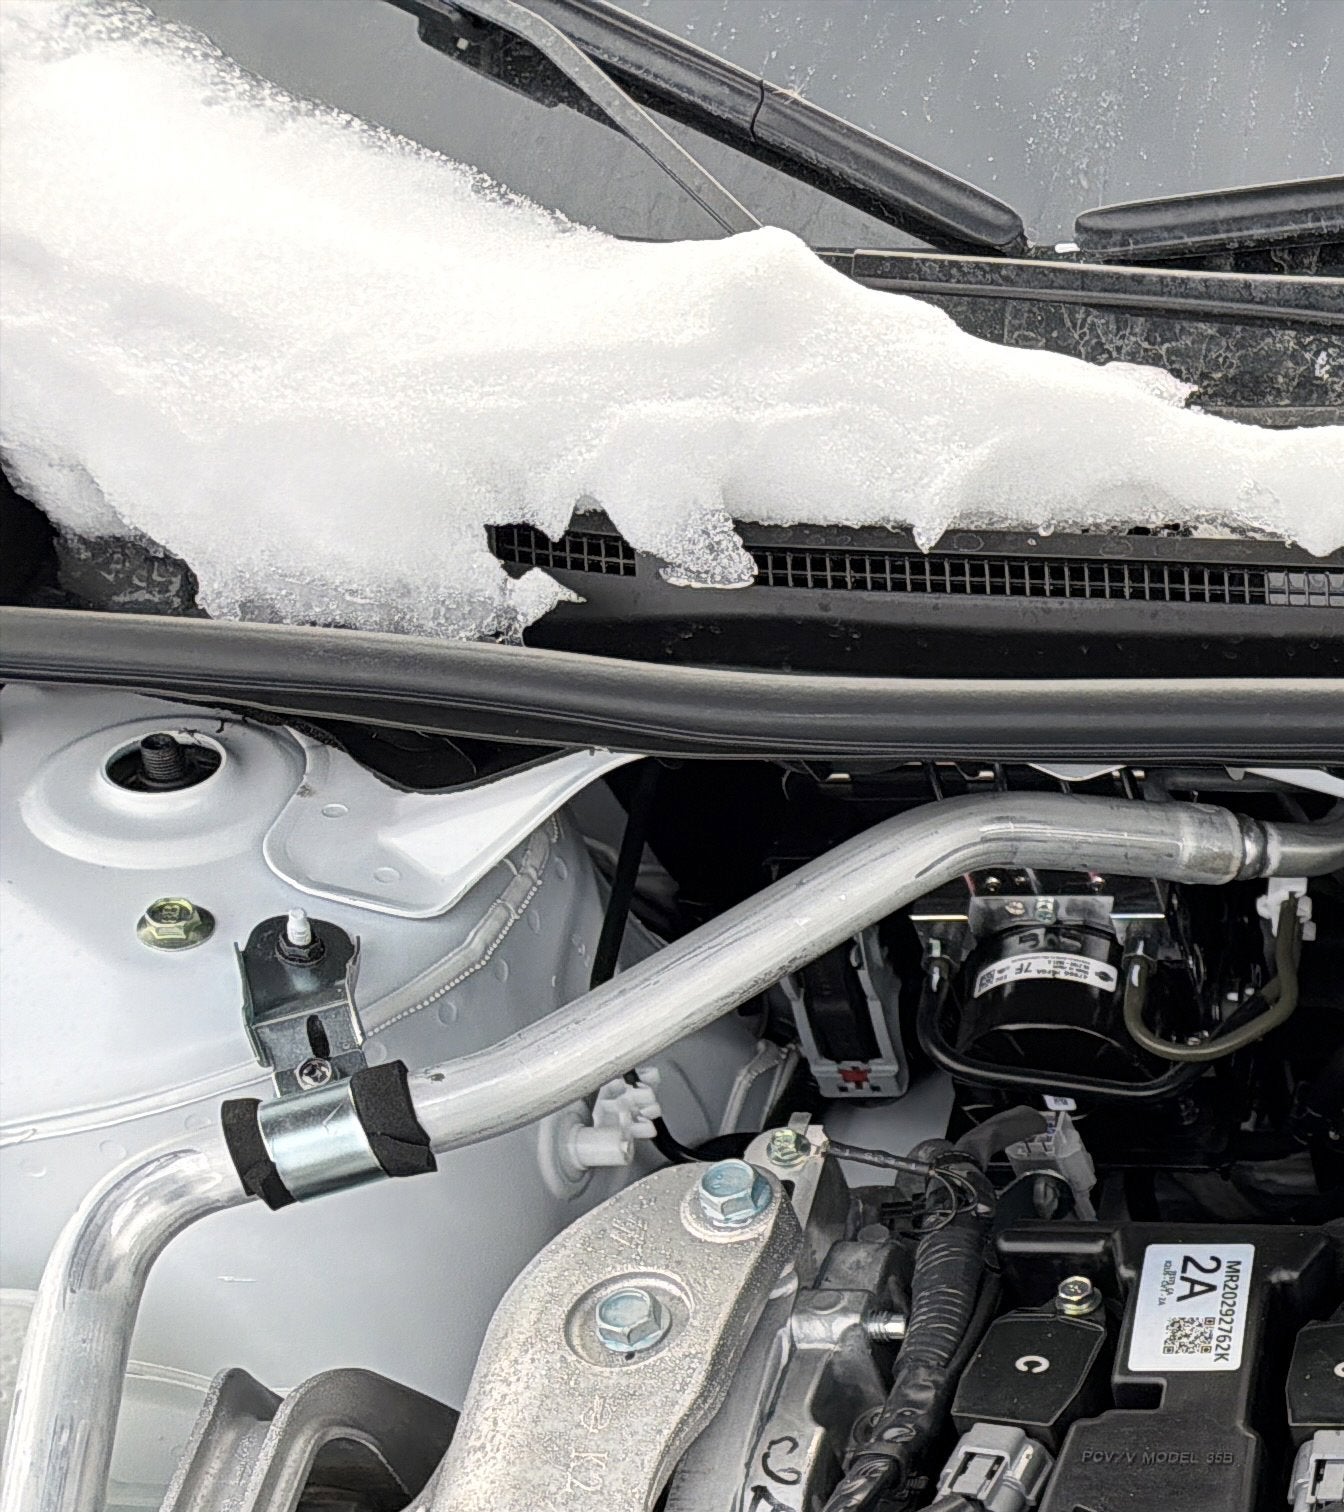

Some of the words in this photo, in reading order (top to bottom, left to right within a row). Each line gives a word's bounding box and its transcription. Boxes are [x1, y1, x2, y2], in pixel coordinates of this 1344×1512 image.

[1014, 960, 1032, 975] 7F
[1175, 1254, 1222, 1302] 2A
[1213, 1260, 1242, 1362] MR20292762K
[1014, 1354, 1051, 1375] C
[1142, 1451, 1198, 1464] MODEL
